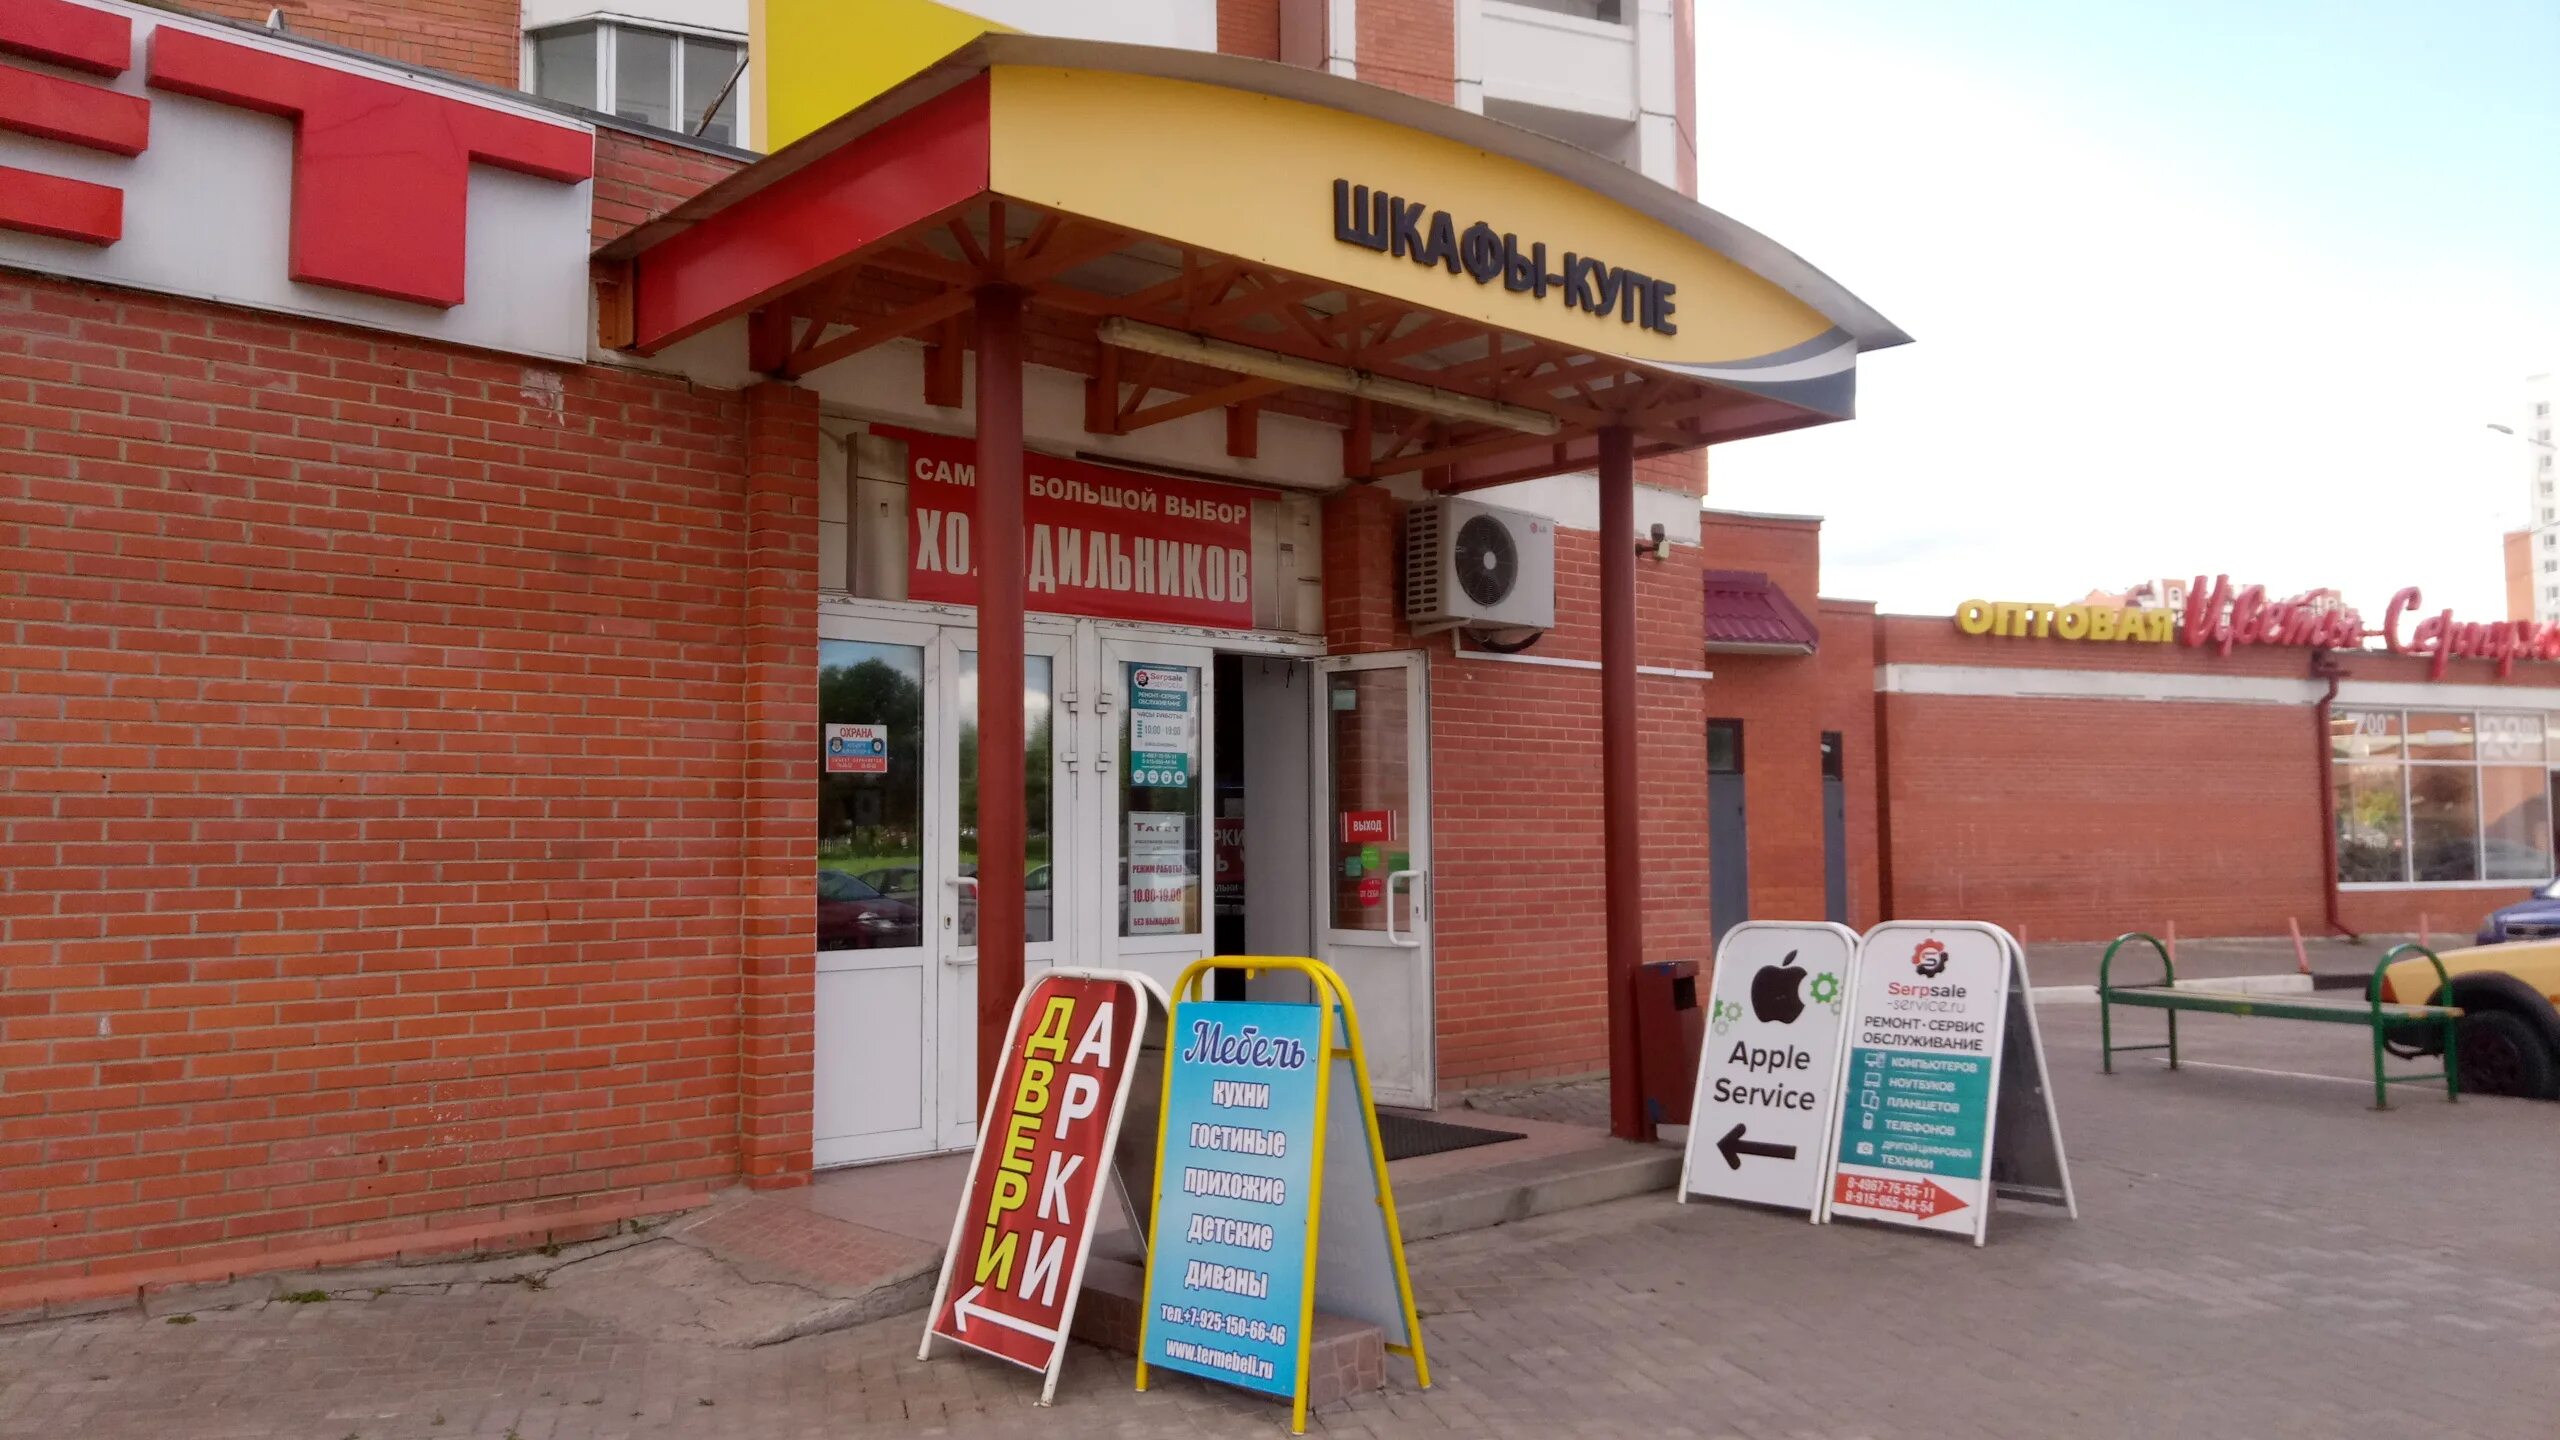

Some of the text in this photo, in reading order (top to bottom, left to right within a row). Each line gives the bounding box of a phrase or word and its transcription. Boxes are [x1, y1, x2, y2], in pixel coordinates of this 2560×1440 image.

[1333, 178, 1678, 336] ШКАФЫ-КУПЕ
[1029, 474, 1157, 513] БОЛЬШОЙ
[1165, 495, 1247, 525] ВЫБОР
[916, 507, 1249, 603] ХОДИЛЬНИКОВ
[1954, 599, 2173, 642] ОПТОВАЯ
[840, 727, 873, 738] ОХРАНА
[1353, 820, 1382, 832] ВЫХОД
[1888, 982, 1966, 998] Serpsale
[1183, 1019, 1307, 1071] Мебель
[1728, 1040, 1811, 1074] Apple
[1862, 1032, 1984, 1051] ОБСЛУЖИВАНИЕ
[1891, 1057, 1978, 1074] КОМПЬЮТЕРОВ
[1211, 1079, 1270, 1110] кухни
[1713, 1077, 1816, 1111] Service
[1888, 1078, 1956, 1092] НОУТБУКОВ
[1886, 1096, 1960, 1113] ПЛАНШЕТОВ
[974, 995, 1077, 1292] ДВЕРИ
[1884, 1119, 1956, 1137] ТЕЛЕФОНОВ
[1018, 1001, 1114, 1308] АРКИ
[1881, 1153, 1934, 1170] ТЕХНИКИ
[1183, 1166, 1286, 1206] прихожие
[1187, 1213, 1274, 1252] детские
[1184, 1259, 1269, 1300] диваны
[1166, 1338, 1275, 1380] www.termebeli.ru
